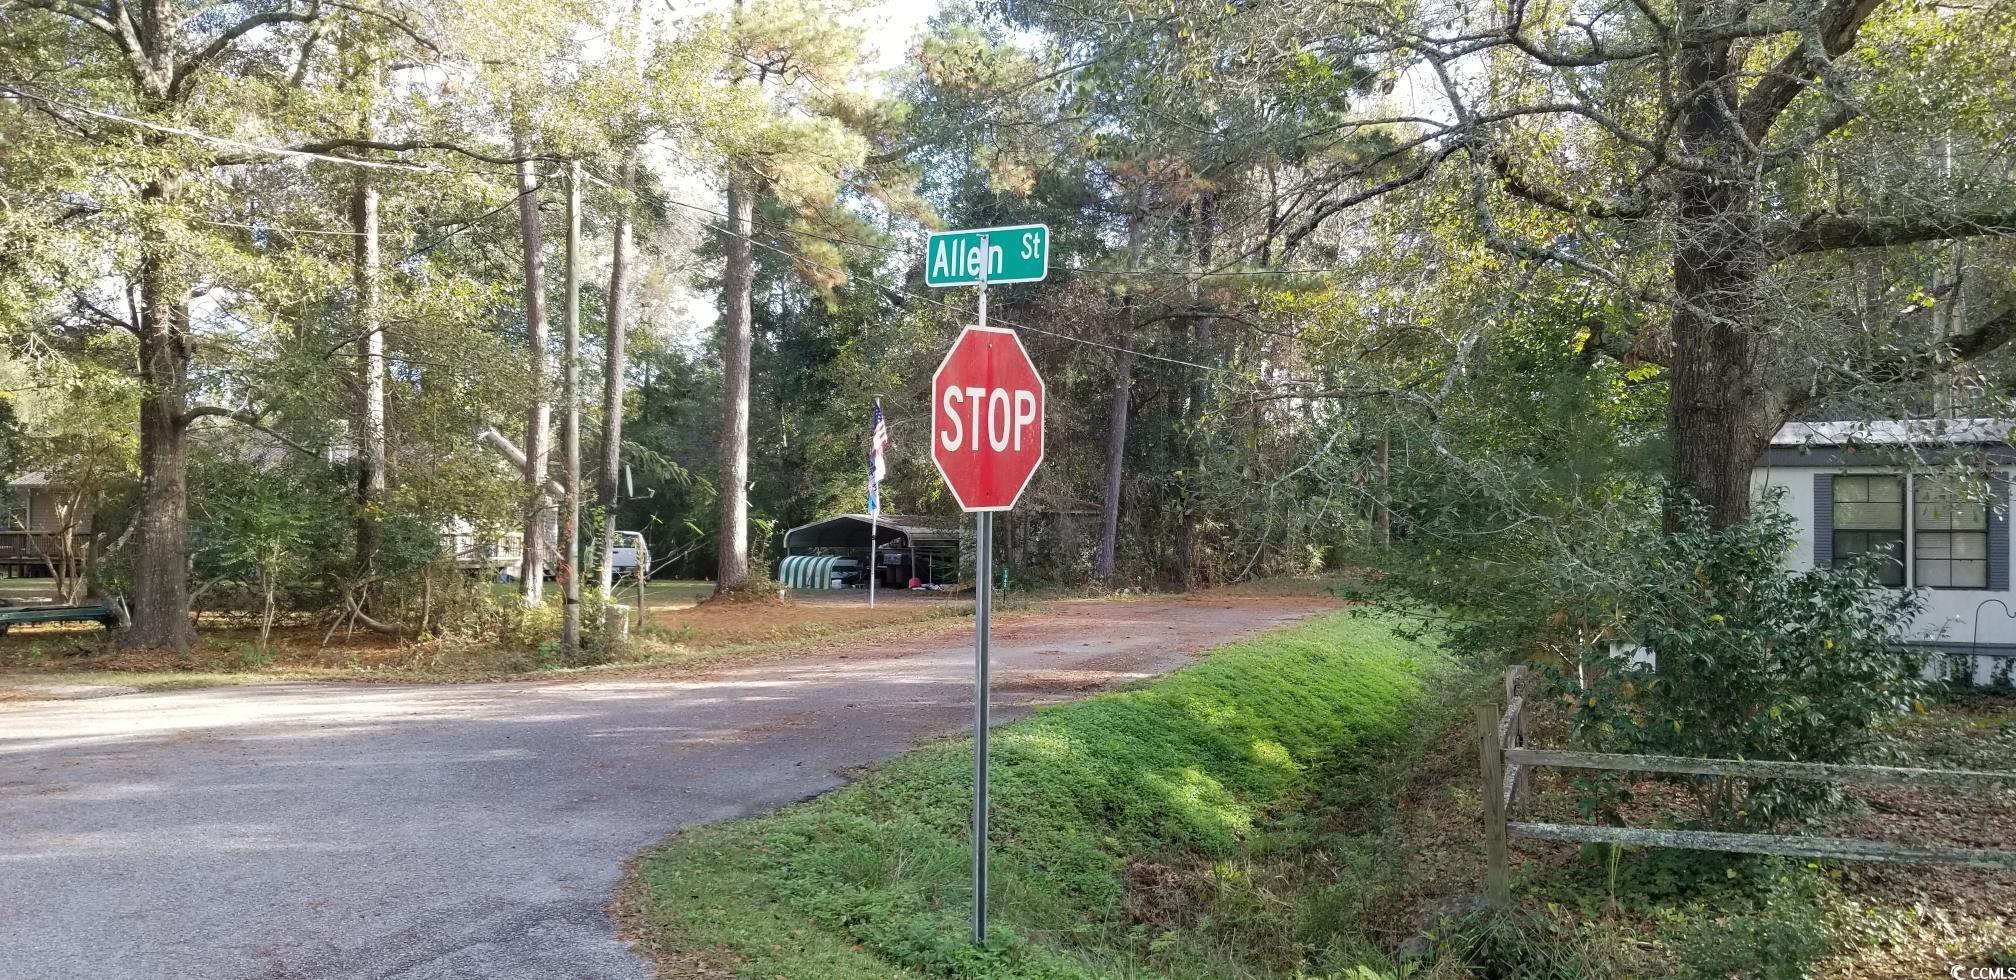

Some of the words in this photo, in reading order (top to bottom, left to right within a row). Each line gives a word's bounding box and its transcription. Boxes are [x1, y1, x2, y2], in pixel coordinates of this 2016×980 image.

[932, 238, 1003, 277] Allen
[1020, 232, 1040, 259] St
[941, 385, 1036, 451] STOP
